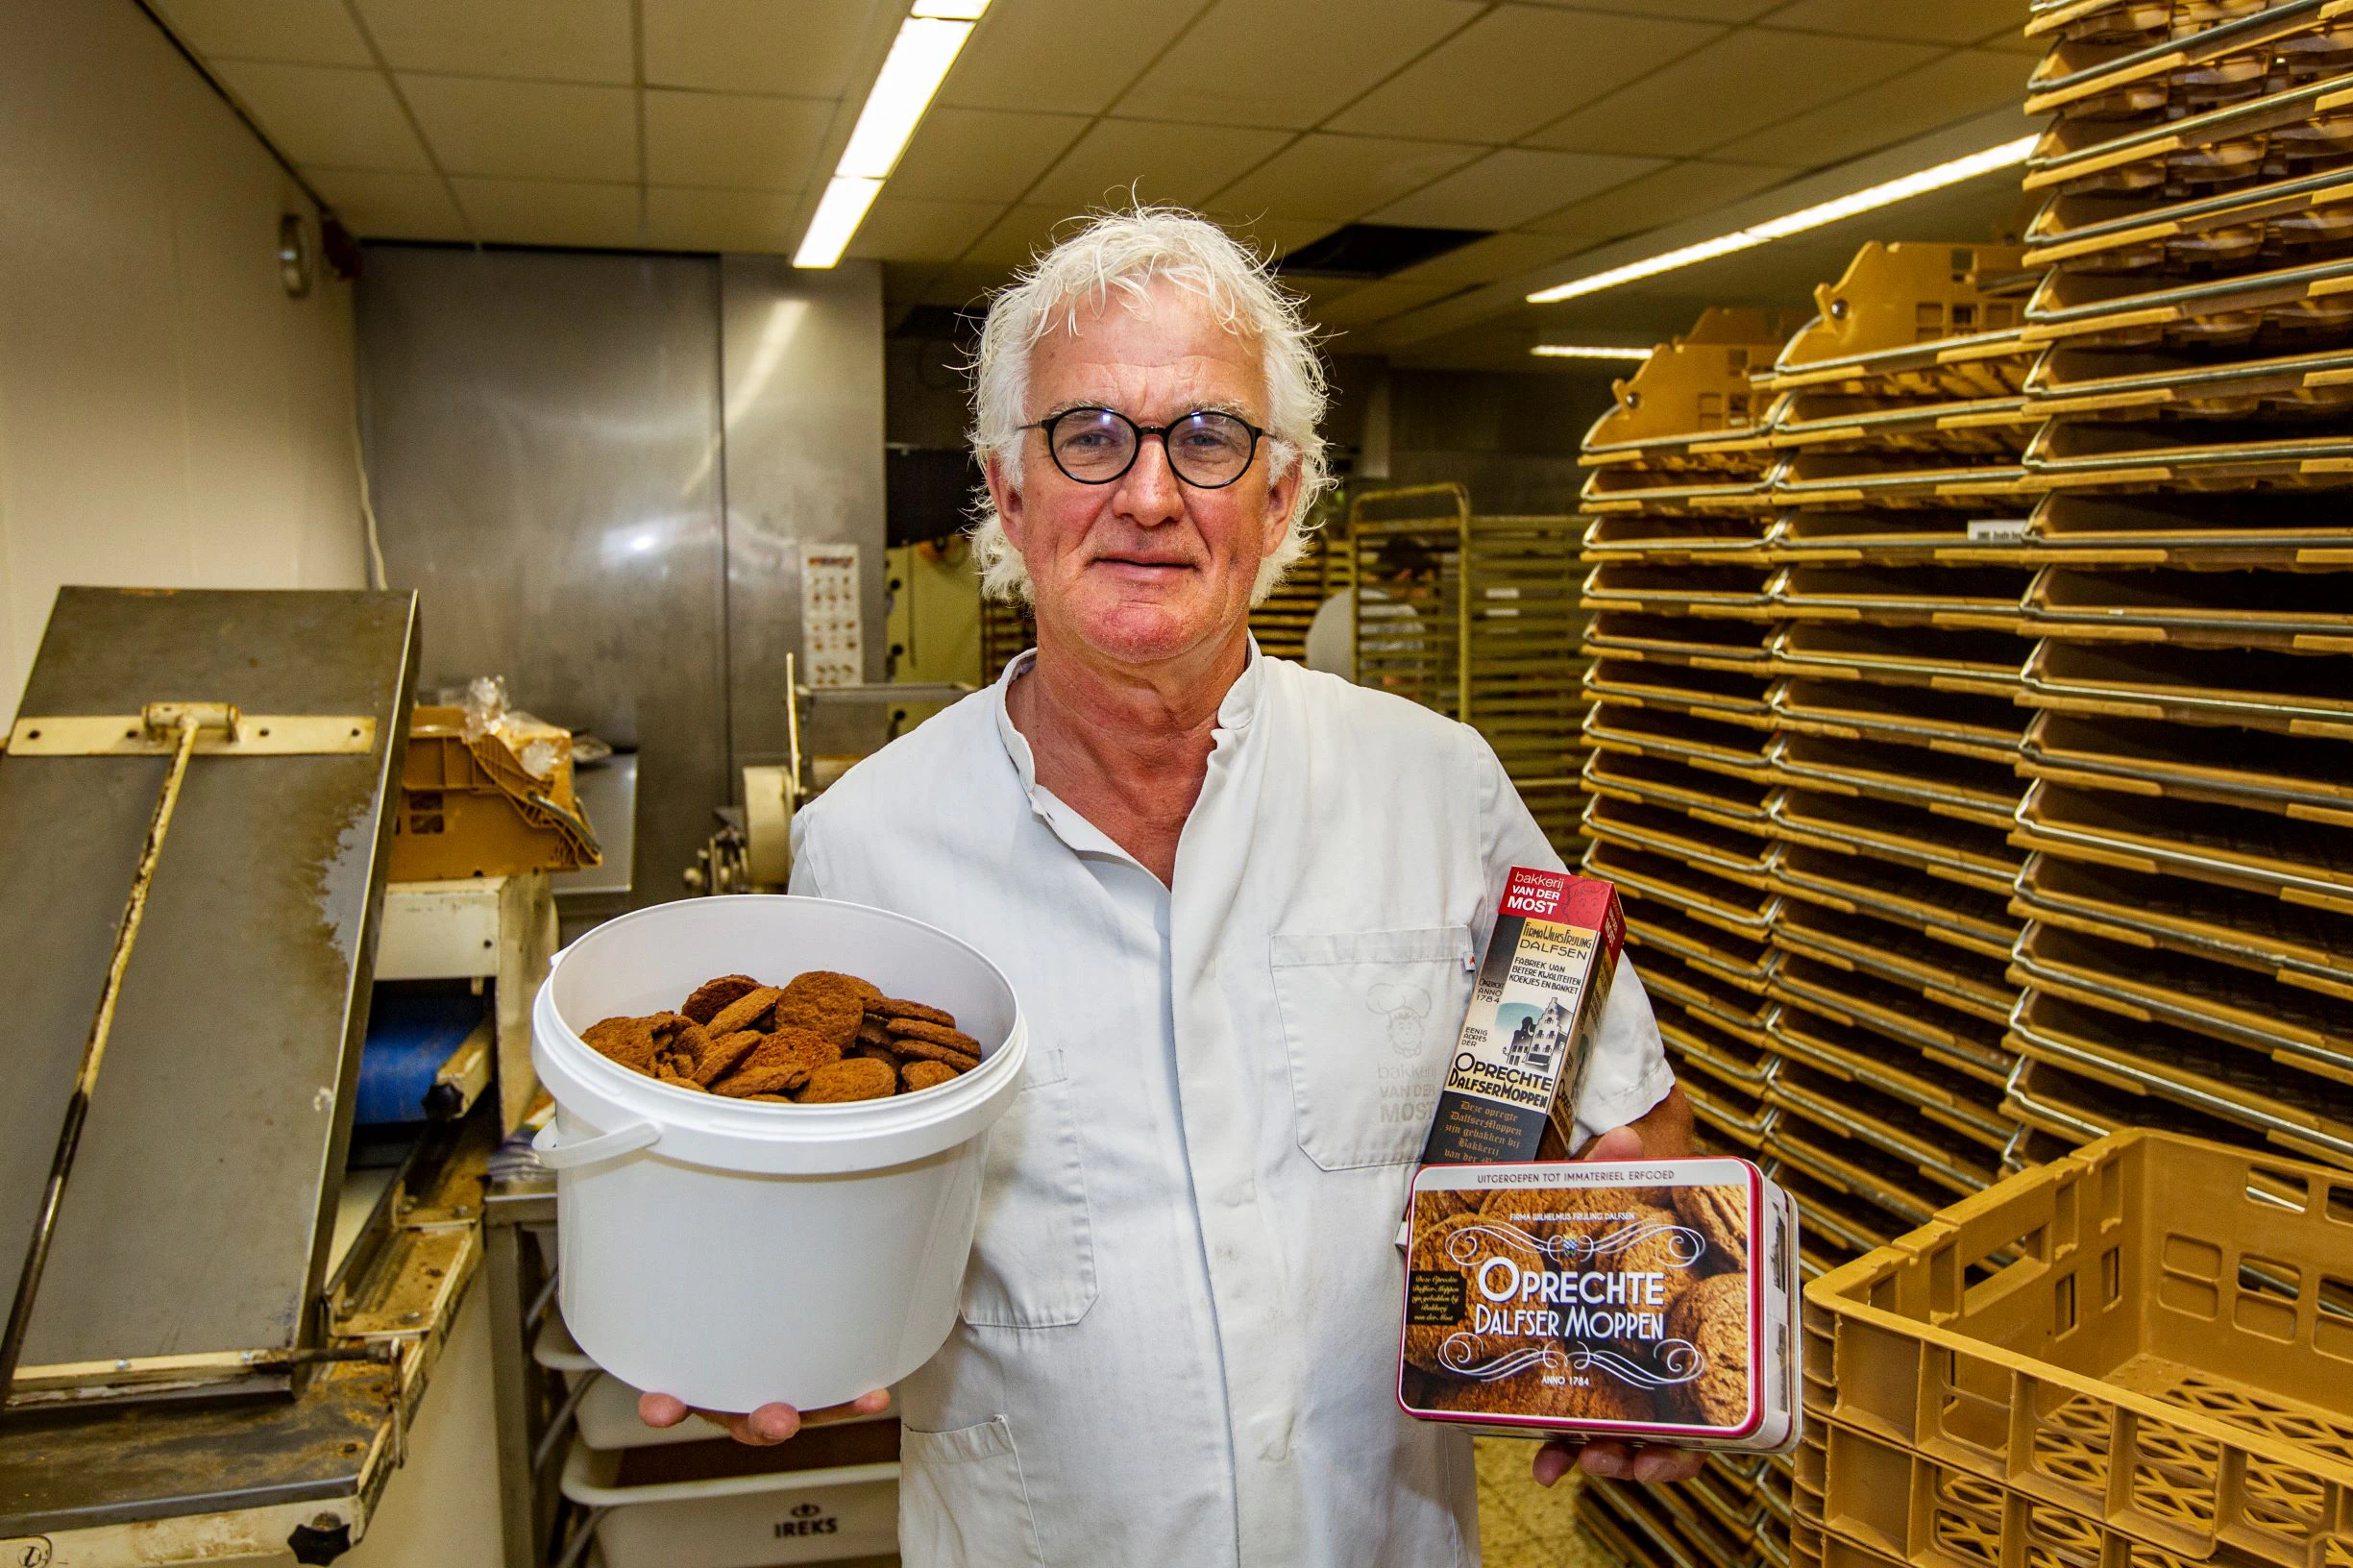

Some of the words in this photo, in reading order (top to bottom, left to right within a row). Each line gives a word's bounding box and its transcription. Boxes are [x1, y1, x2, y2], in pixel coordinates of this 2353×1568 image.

[1515, 871, 1564, 892] bakkerij
[1512, 885, 1534, 896] VAN
[1536, 889, 1560, 901] DER
[1507, 895, 1557, 915] MOST
[1520, 939, 1587, 961] DALFSEN
[1514, 956, 1547, 969] FABRIEK
[1508, 974, 1540, 987] KOEKJES
[1551, 981, 1580, 994] BANKET
[1511, 966, 1537, 977] BETERE
[1538, 969, 1581, 986] KWALITEITEN
[1477, 994, 1500, 1004] 1784
[1478, 988, 1502, 996] ANNO
[1463, 1033, 1487, 1042] ADRES
[1465, 1027, 1488, 1037] EENIG
[1456, 1052, 1554, 1092] OPRECHTE
[1380, 1085, 1409, 1098] VAN
[1381, 1101, 1434, 1123] MOST
[1477, 1173, 1538, 1184] UITGEROEPEN
[1543, 1172, 1560, 1182] TOT
[1564, 1171, 1625, 1182] IMMATERIEEL
[1629, 1170, 1675, 1180] ERFGOED
[1509, 1213, 1531, 1221] FIRMA
[1478, 1256, 1665, 1306] OPRECHTE
[1475, 1303, 1559, 1336] DALFSER
[1564, 1306, 1664, 1340] MOPPEN
[1541, 1375, 1565, 1384] ANNO
[1569, 1376, 1590, 1385] 1784
[774, 1518, 838, 1538] IREKS
